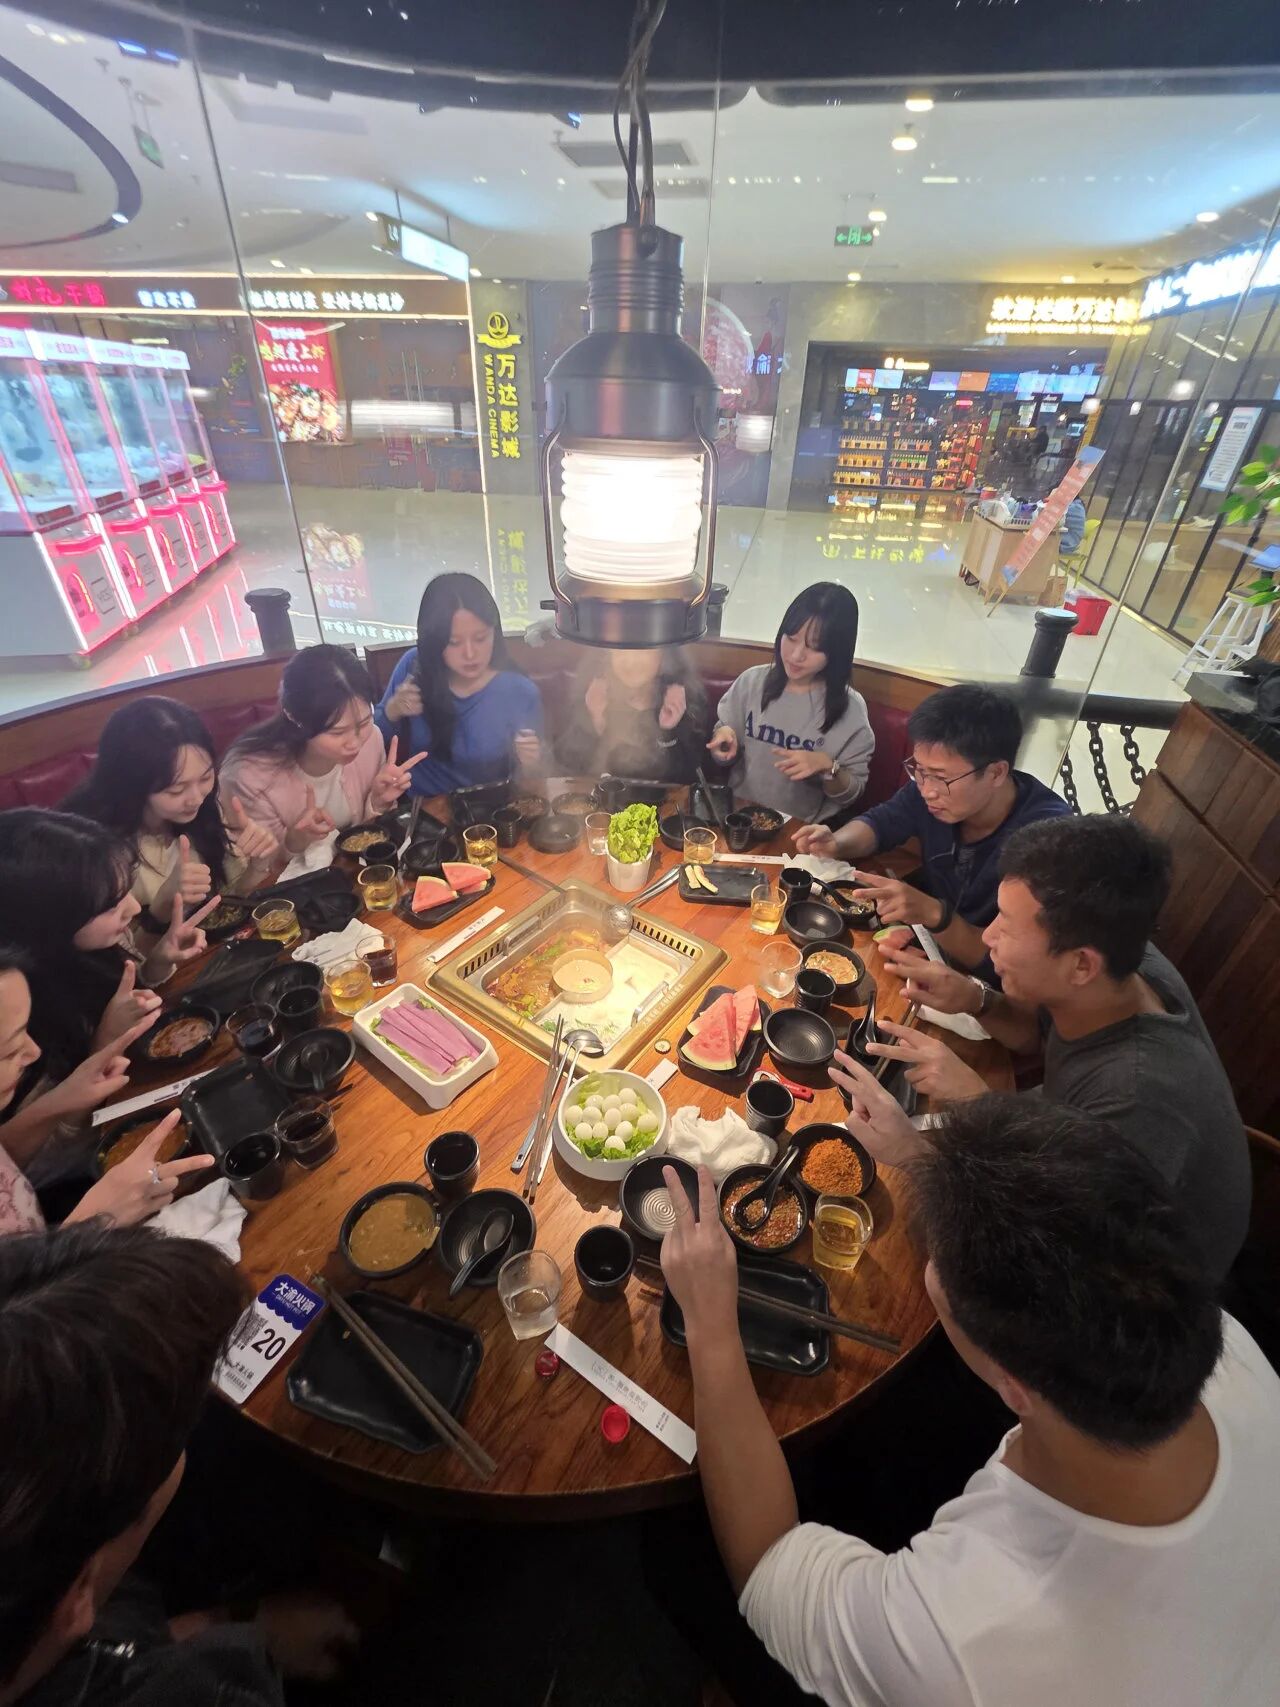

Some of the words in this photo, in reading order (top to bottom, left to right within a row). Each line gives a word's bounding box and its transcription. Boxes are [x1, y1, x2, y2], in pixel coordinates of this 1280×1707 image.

[483, 353, 497, 406] WANDA
[496, 353, 521, 459] 万达影城
[487, 408, 500, 458] CINEMA
[274, 1281, 316, 1315] 大渝火锅
[251, 1328, 286, 1361] 20
